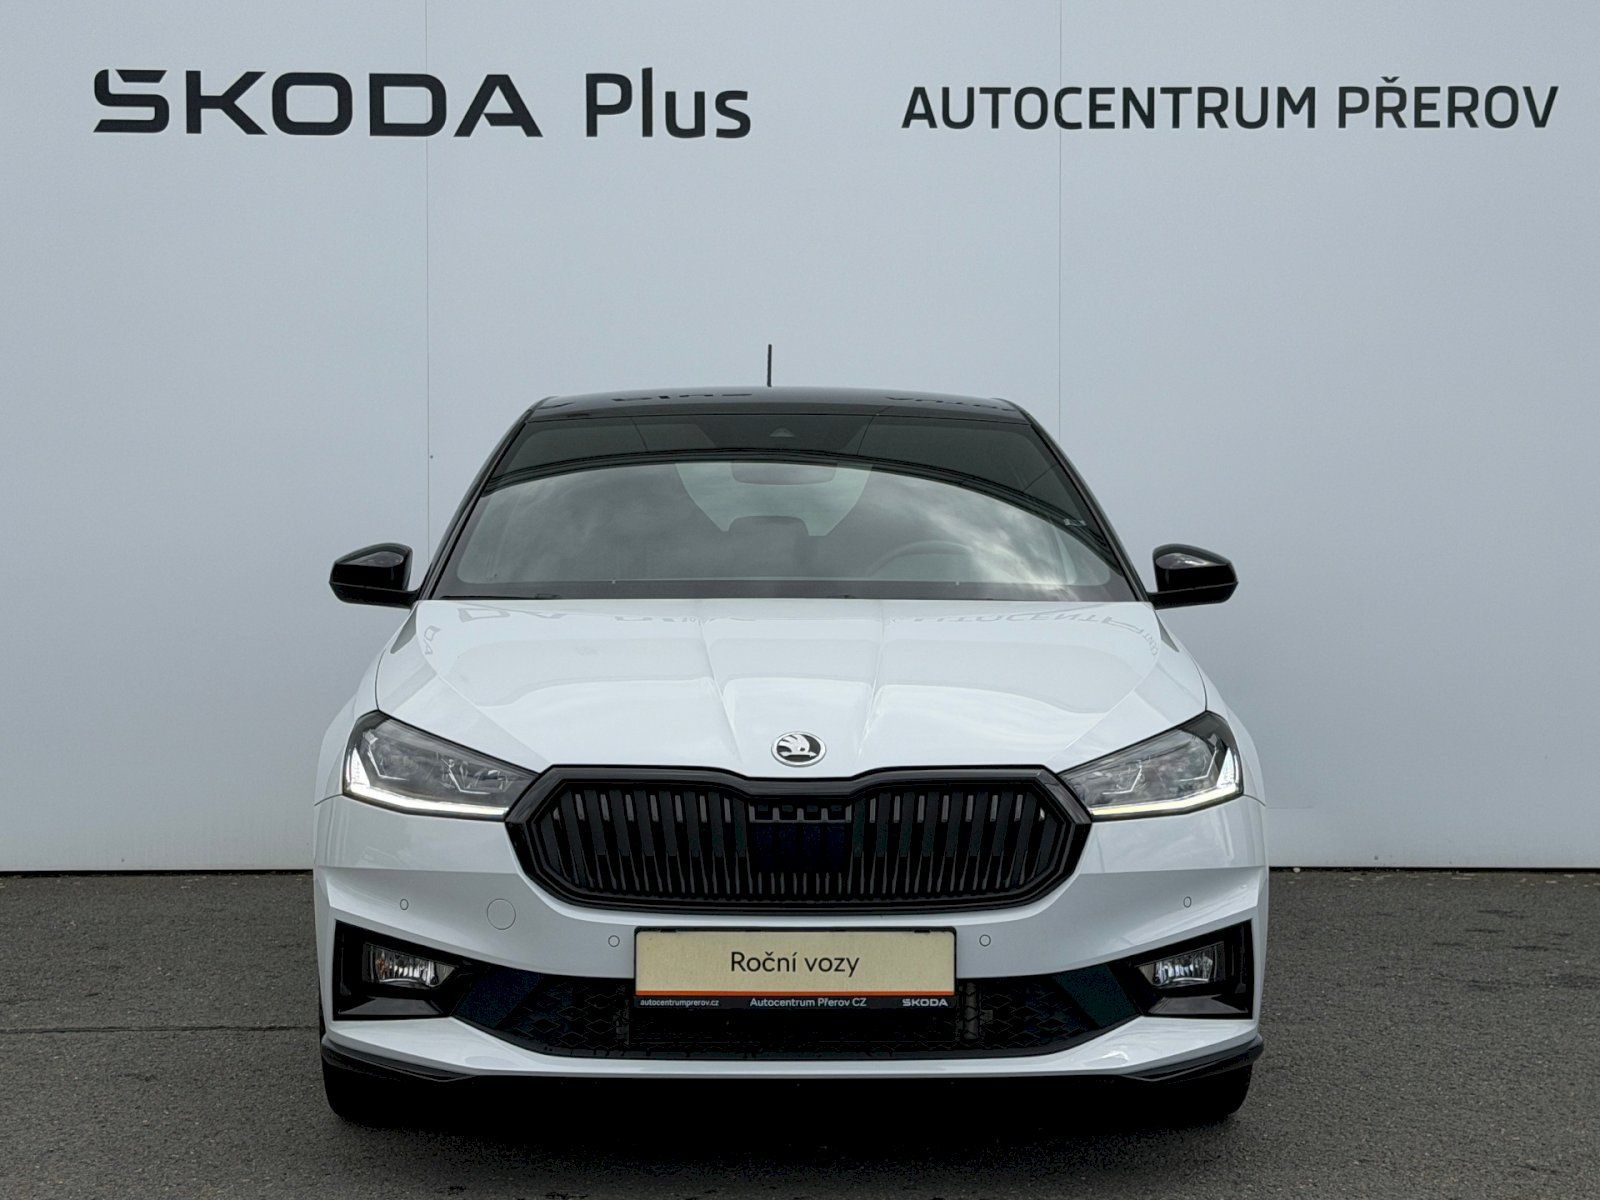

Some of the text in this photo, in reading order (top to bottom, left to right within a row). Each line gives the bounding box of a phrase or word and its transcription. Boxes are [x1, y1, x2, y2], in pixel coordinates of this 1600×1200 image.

[585, 67, 751, 139] Plus
[901, 76, 1559, 130] AUTOCENTRUM PŘEROV
[730, 951, 861, 978] Roční vozy
[640, 998, 720, 1008] autocentrumprerov.cz
[749, 997, 868, 1009] Autocentrum Přerov CZ
